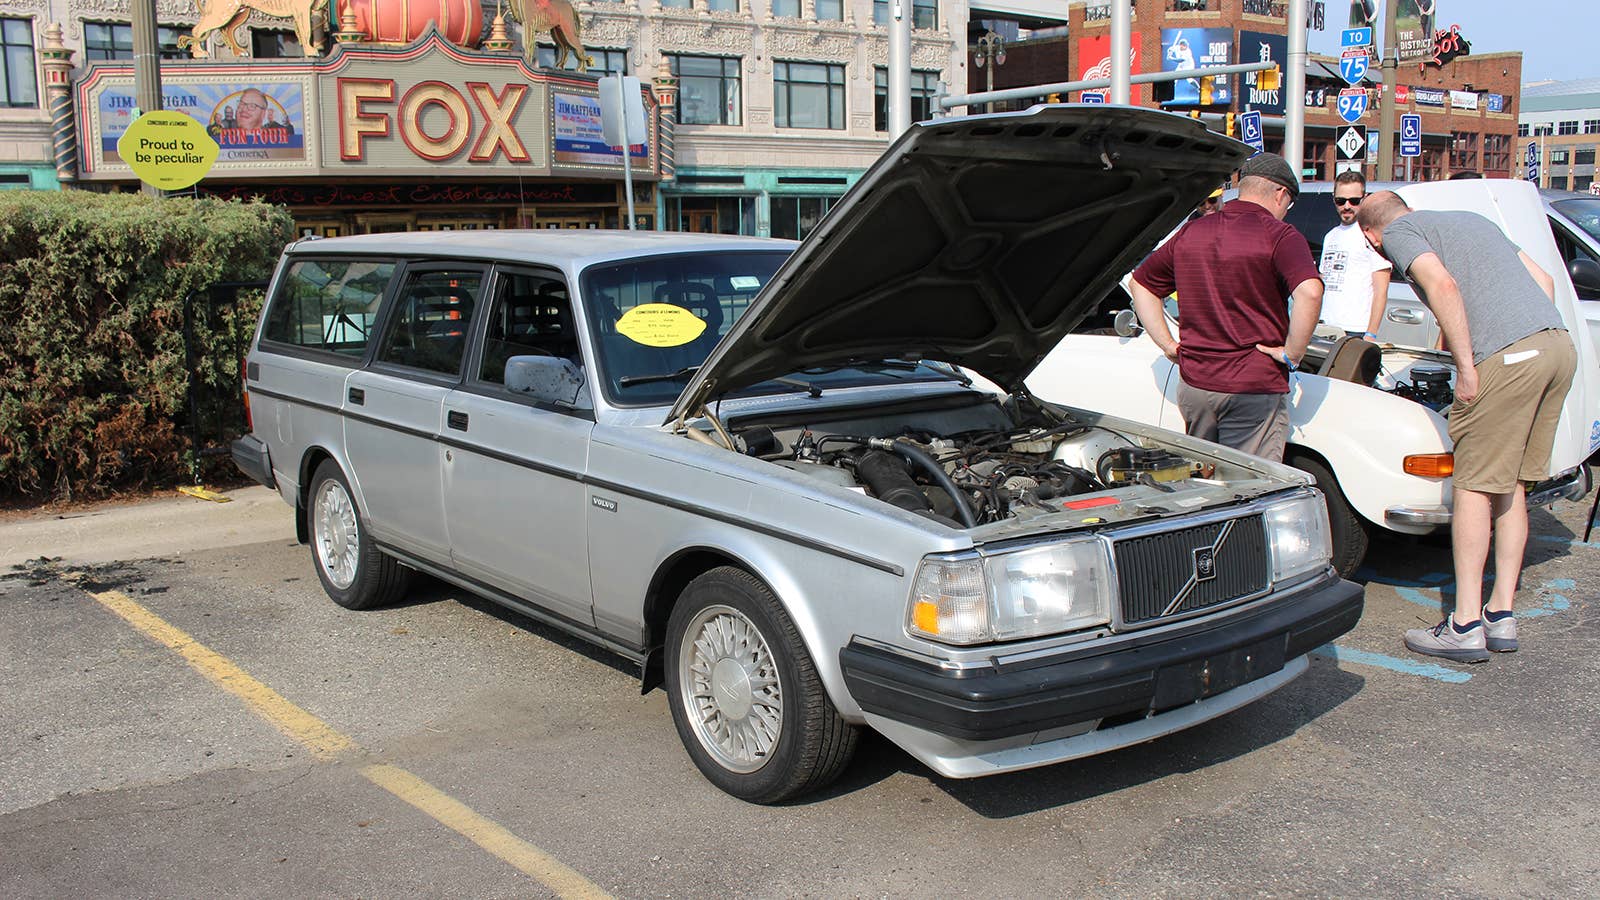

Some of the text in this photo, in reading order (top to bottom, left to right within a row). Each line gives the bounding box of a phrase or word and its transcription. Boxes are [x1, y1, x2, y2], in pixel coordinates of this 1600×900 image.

[1349, 32, 1363, 43] TO
[1400, 31, 1414, 41] THE
[1208, 42, 1227, 56] 500
[1400, 38, 1432, 51] DISTRICT
[1342, 58, 1366, 78] 75
[108, 96, 133, 108] JIM
[1249, 87, 1279, 106] ROOTS
[558, 102, 570, 114] JIM
[1340, 96, 1364, 116] 94
[337, 77, 532, 163] FOX
[220, 127, 289, 144] FUN TOUR
[140, 138, 194, 150] Proud to
[1345, 138, 1358, 151] 10
[135, 152, 204, 165] be peculiar
[409, 184, 577, 203] Entertainment
[592, 497, 615, 509] VOLVO
